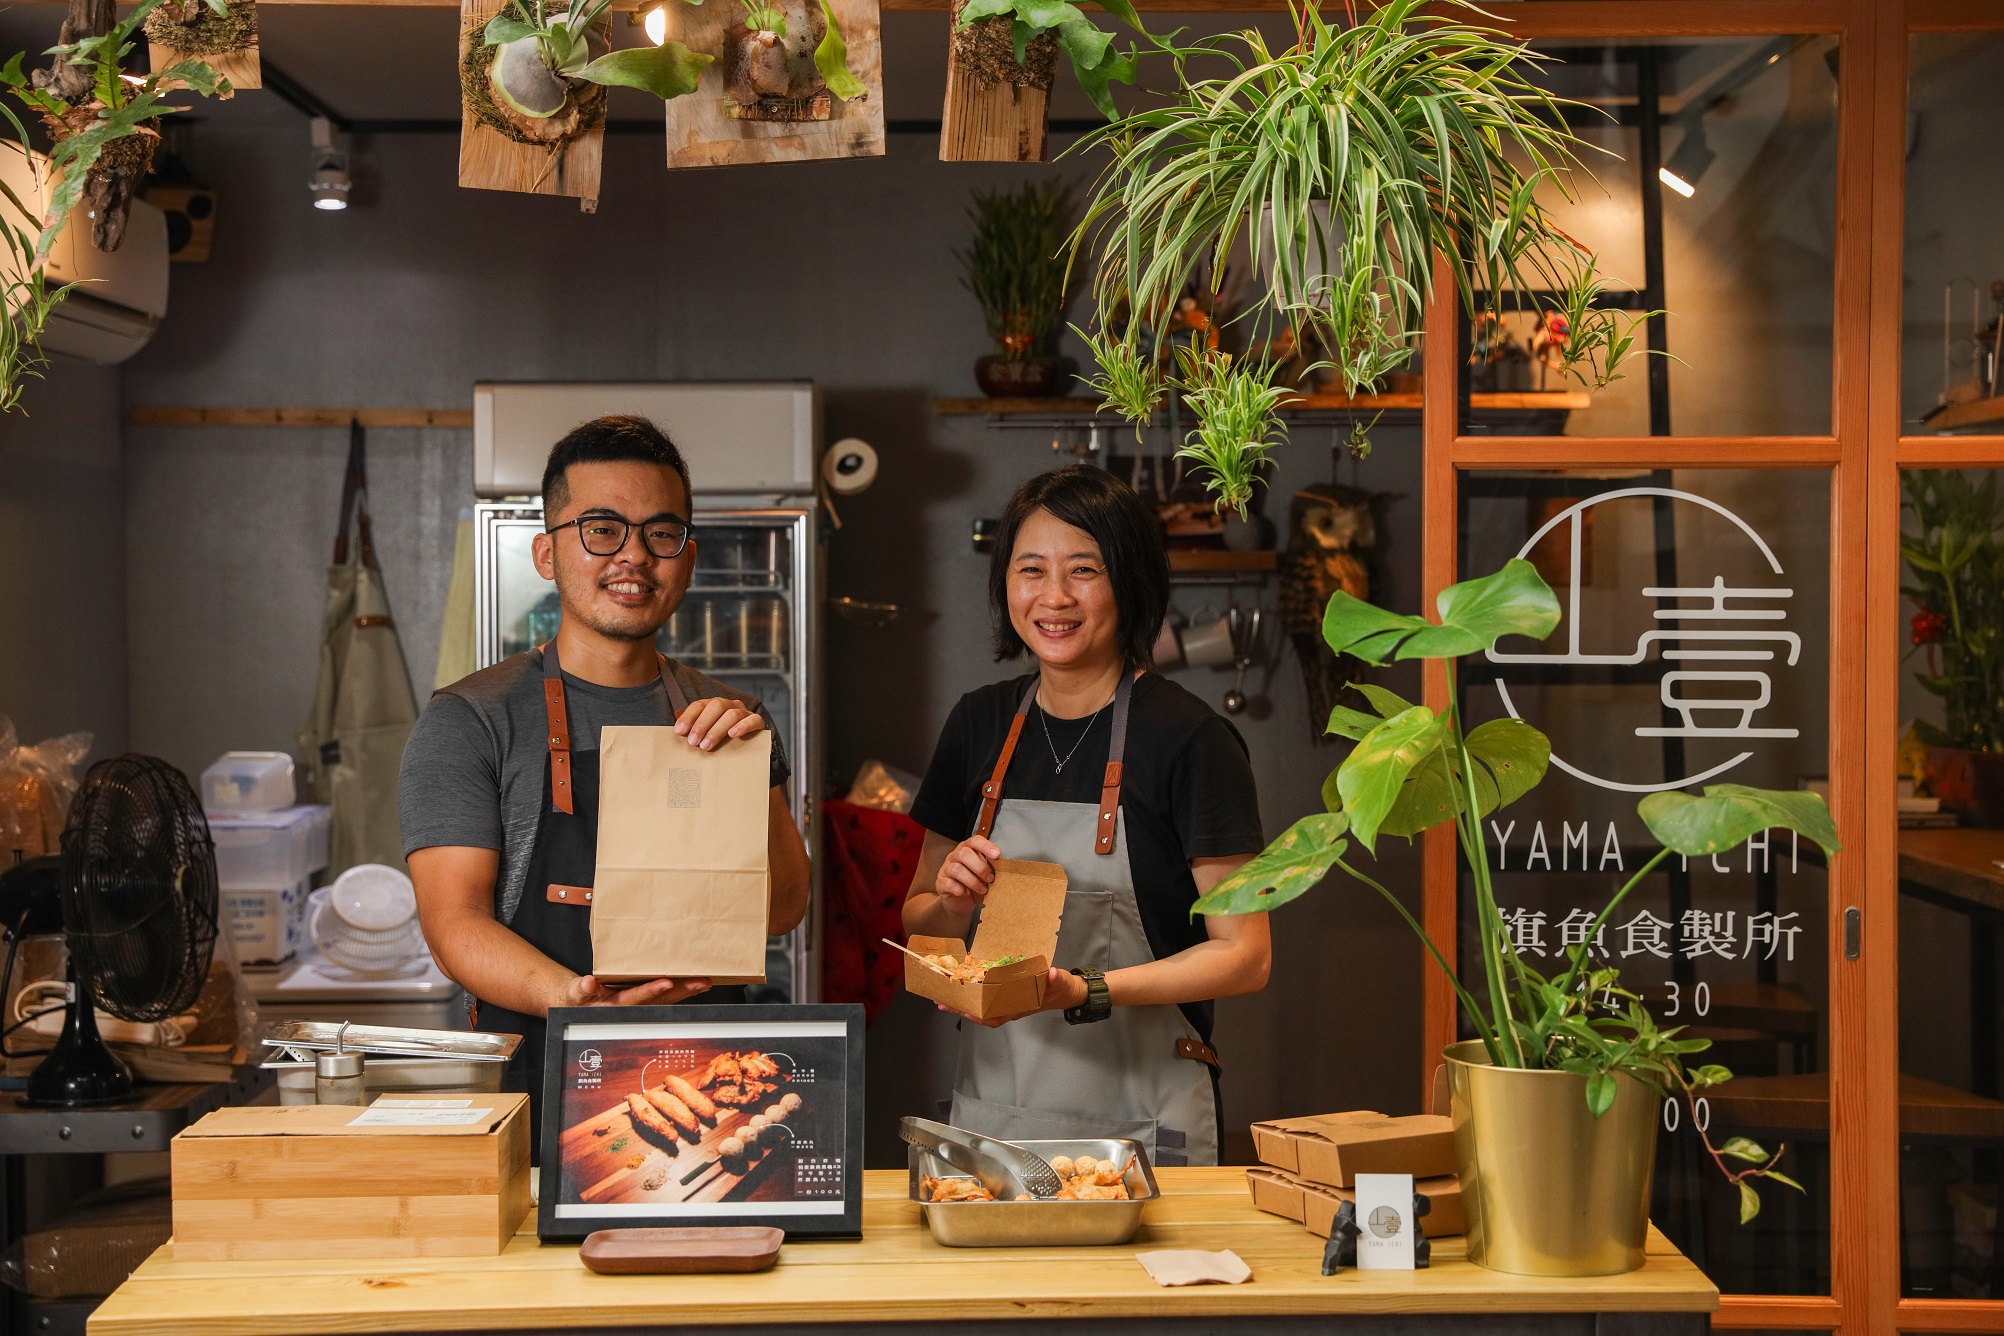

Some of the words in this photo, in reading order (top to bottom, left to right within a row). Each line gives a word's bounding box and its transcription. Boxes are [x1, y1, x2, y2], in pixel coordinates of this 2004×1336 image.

[1491, 820, 1624, 872] YAMA
[1498, 907, 1803, 961] 旗魚食製所
